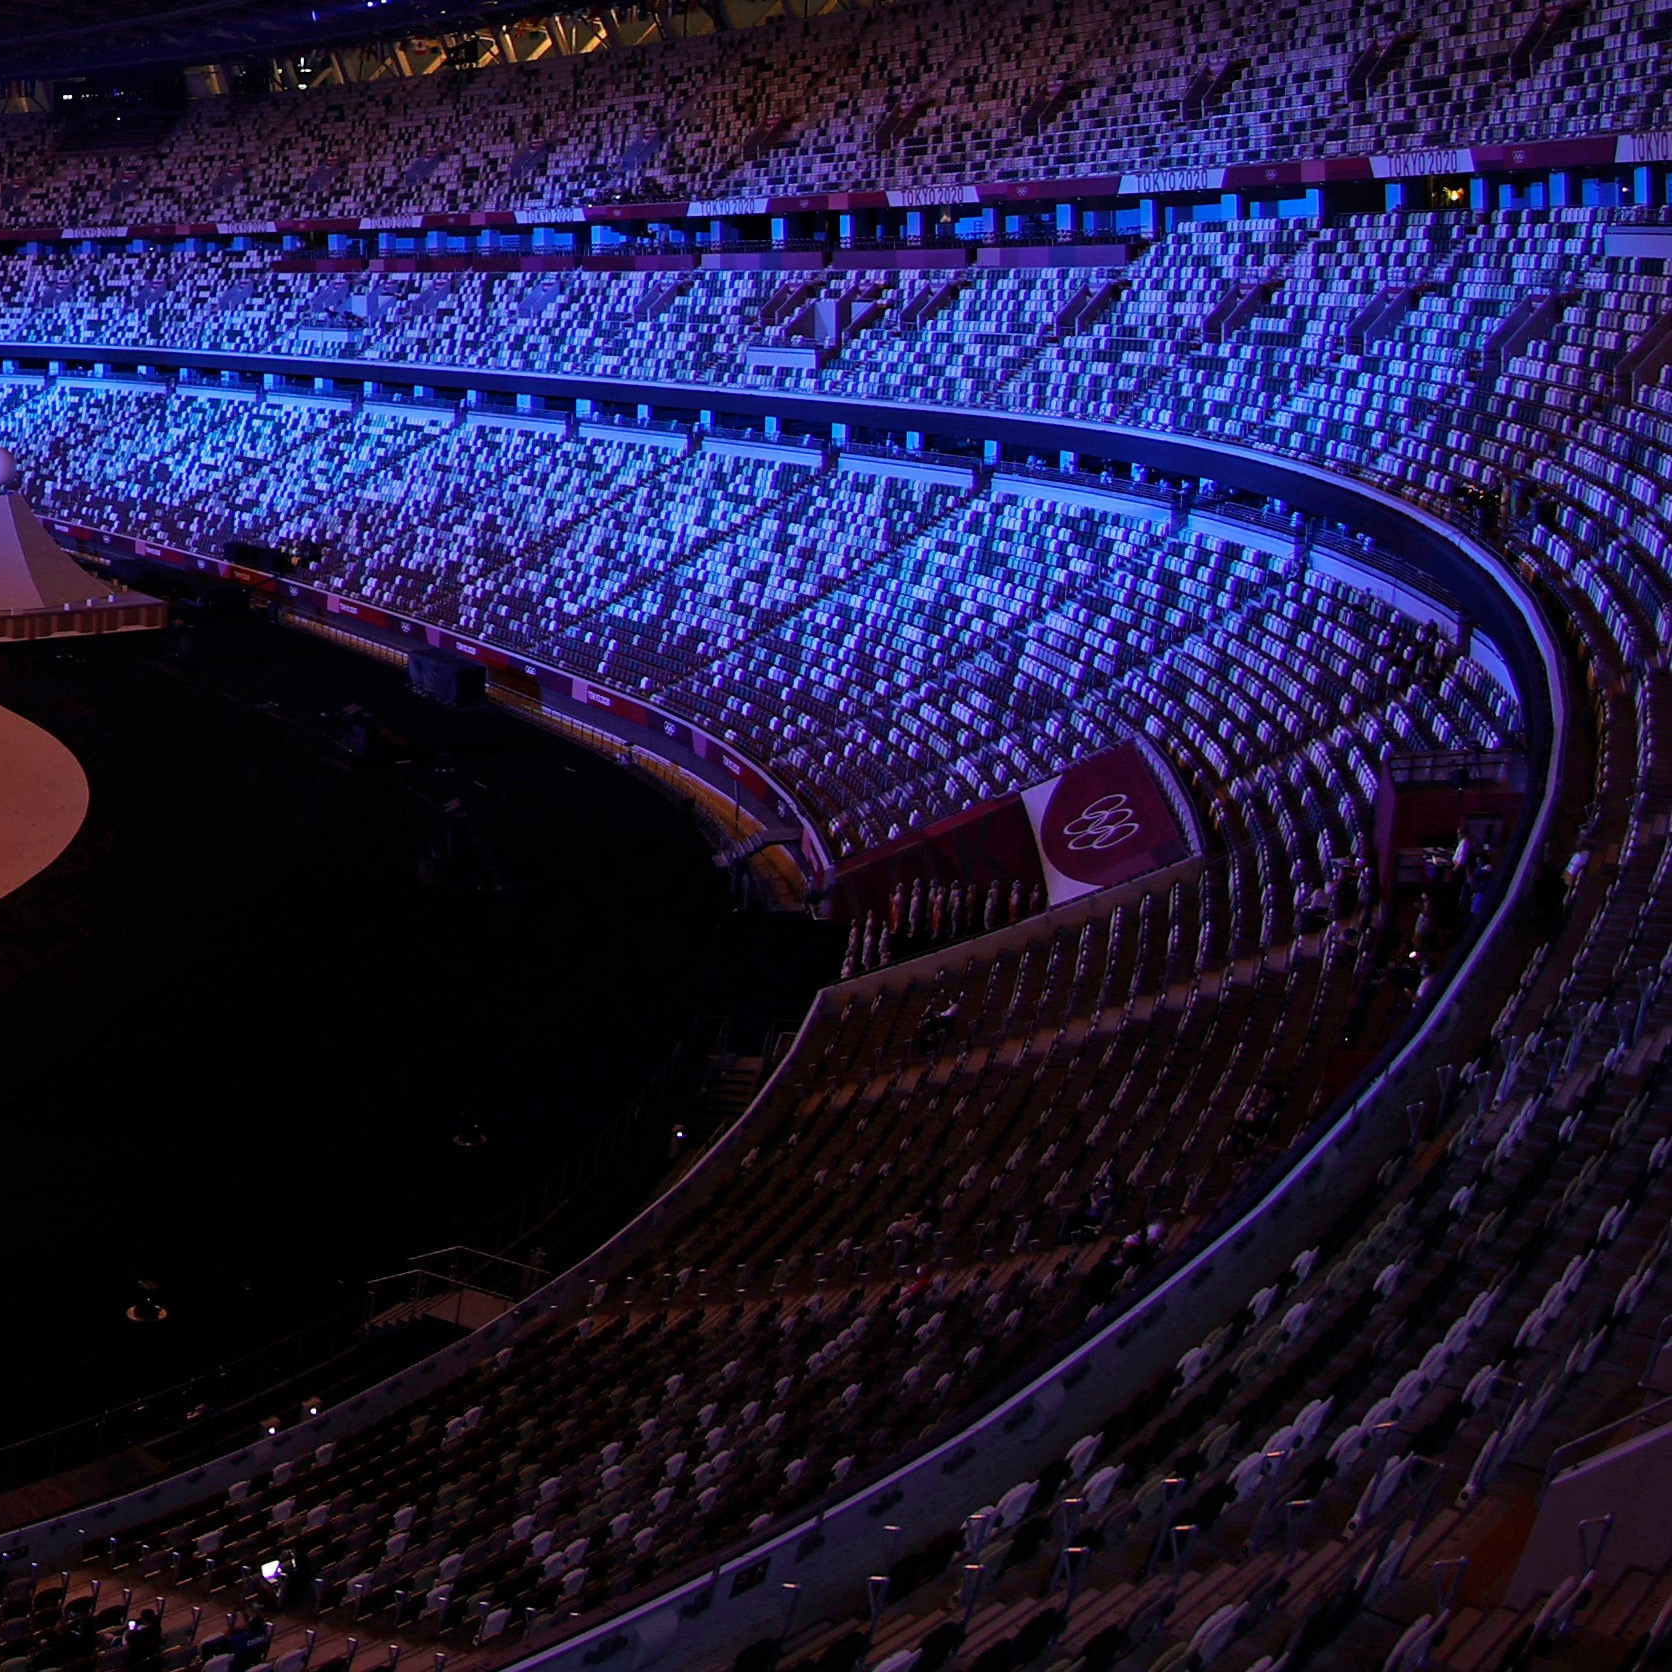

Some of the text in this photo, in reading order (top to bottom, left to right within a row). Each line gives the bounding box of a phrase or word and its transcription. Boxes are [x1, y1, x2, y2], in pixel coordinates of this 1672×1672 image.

[1632, 133, 1668, 160] TOKYO
[1389, 152, 1457, 175] TOKYO 2020
[1137, 171, 1208, 192] TOKYO 2020
[902, 186, 963, 205] TOKYO 2020
[528, 208, 573, 223] TOKYO 2020
[701, 200, 754, 217] TOKYO 2020
